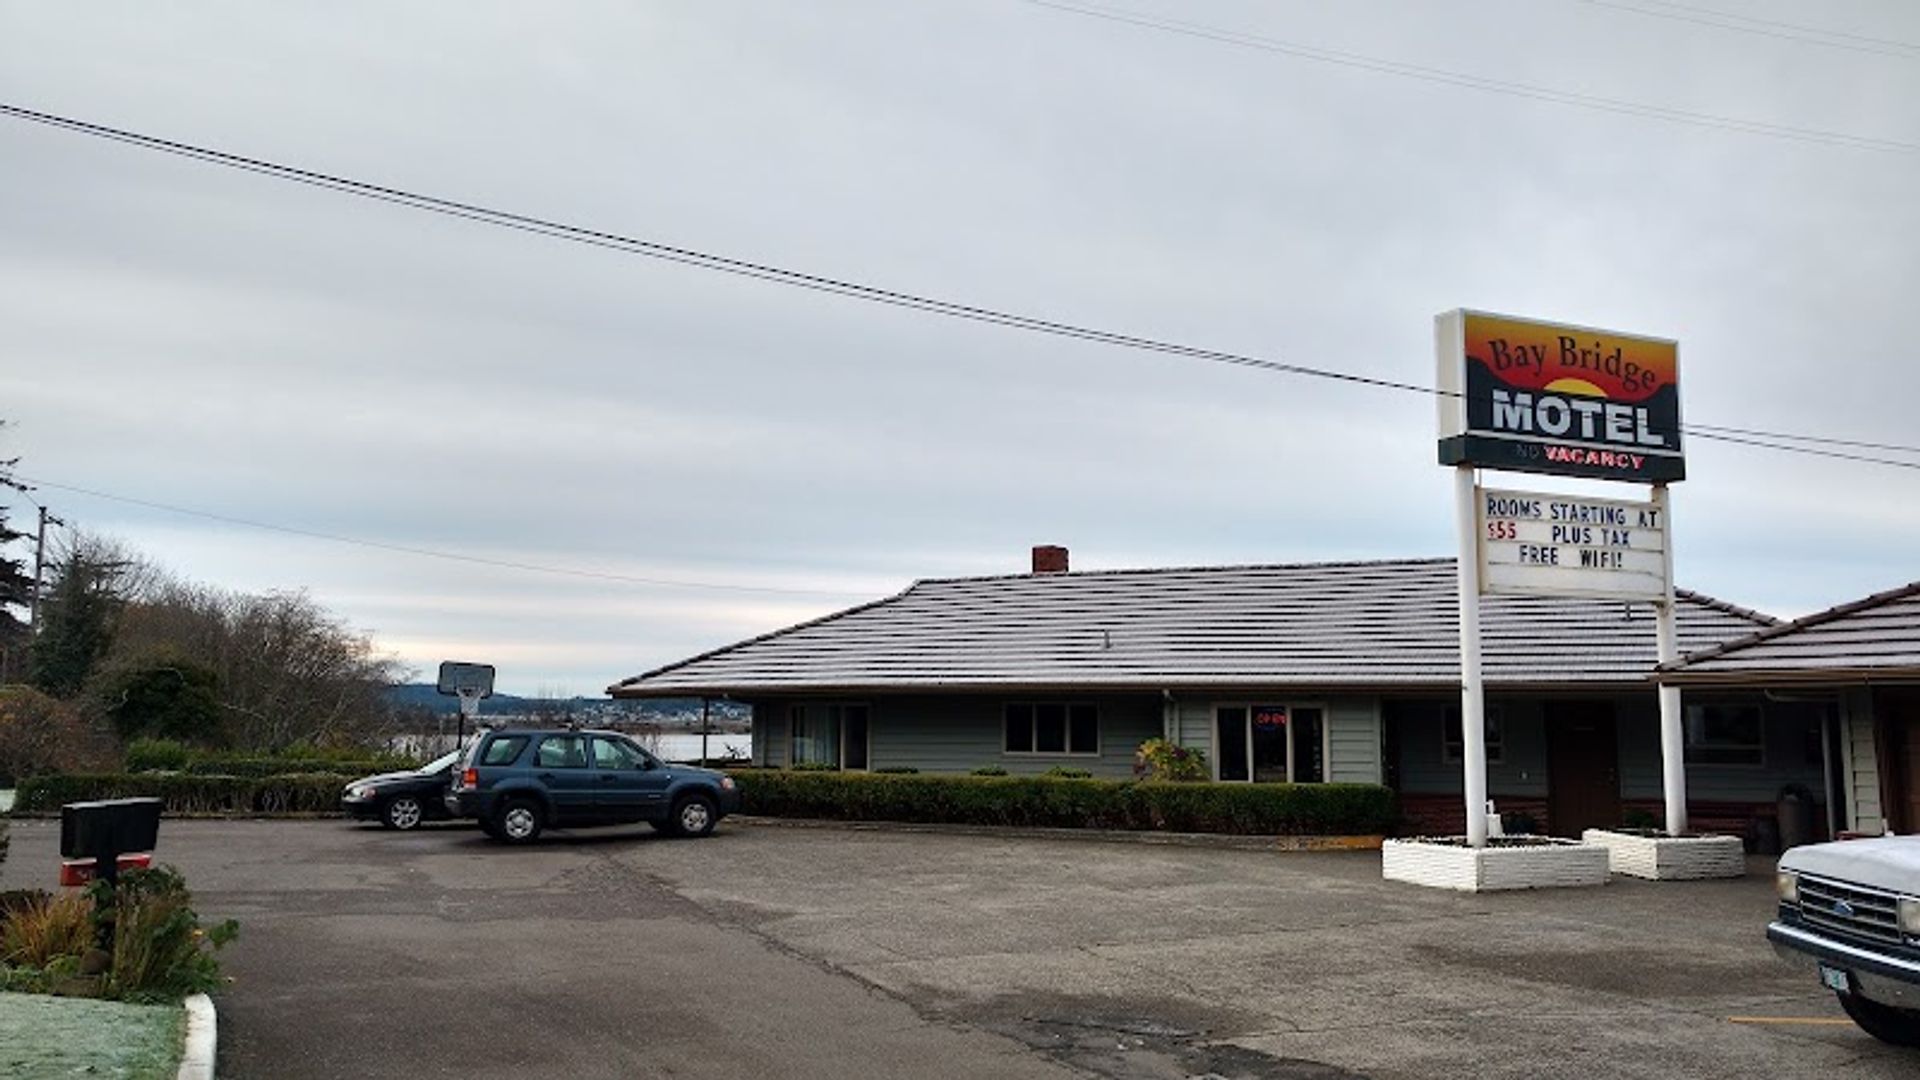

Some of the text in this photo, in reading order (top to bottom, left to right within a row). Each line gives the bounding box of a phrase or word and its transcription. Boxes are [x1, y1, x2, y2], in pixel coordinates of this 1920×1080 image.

[1488, 336, 1656, 393] Bay Bridge
[1492, 389, 1664, 445] MOTEL
[1545, 446, 1645, 469] VACANCY
[1487, 499, 1657, 527] ROOMS STARTING AT
[1487, 521, 1631, 547] $55 PLUS TAX
[1519, 545, 1622, 568] FREE WIFI!
[1255, 712, 1287, 726] OPEN
